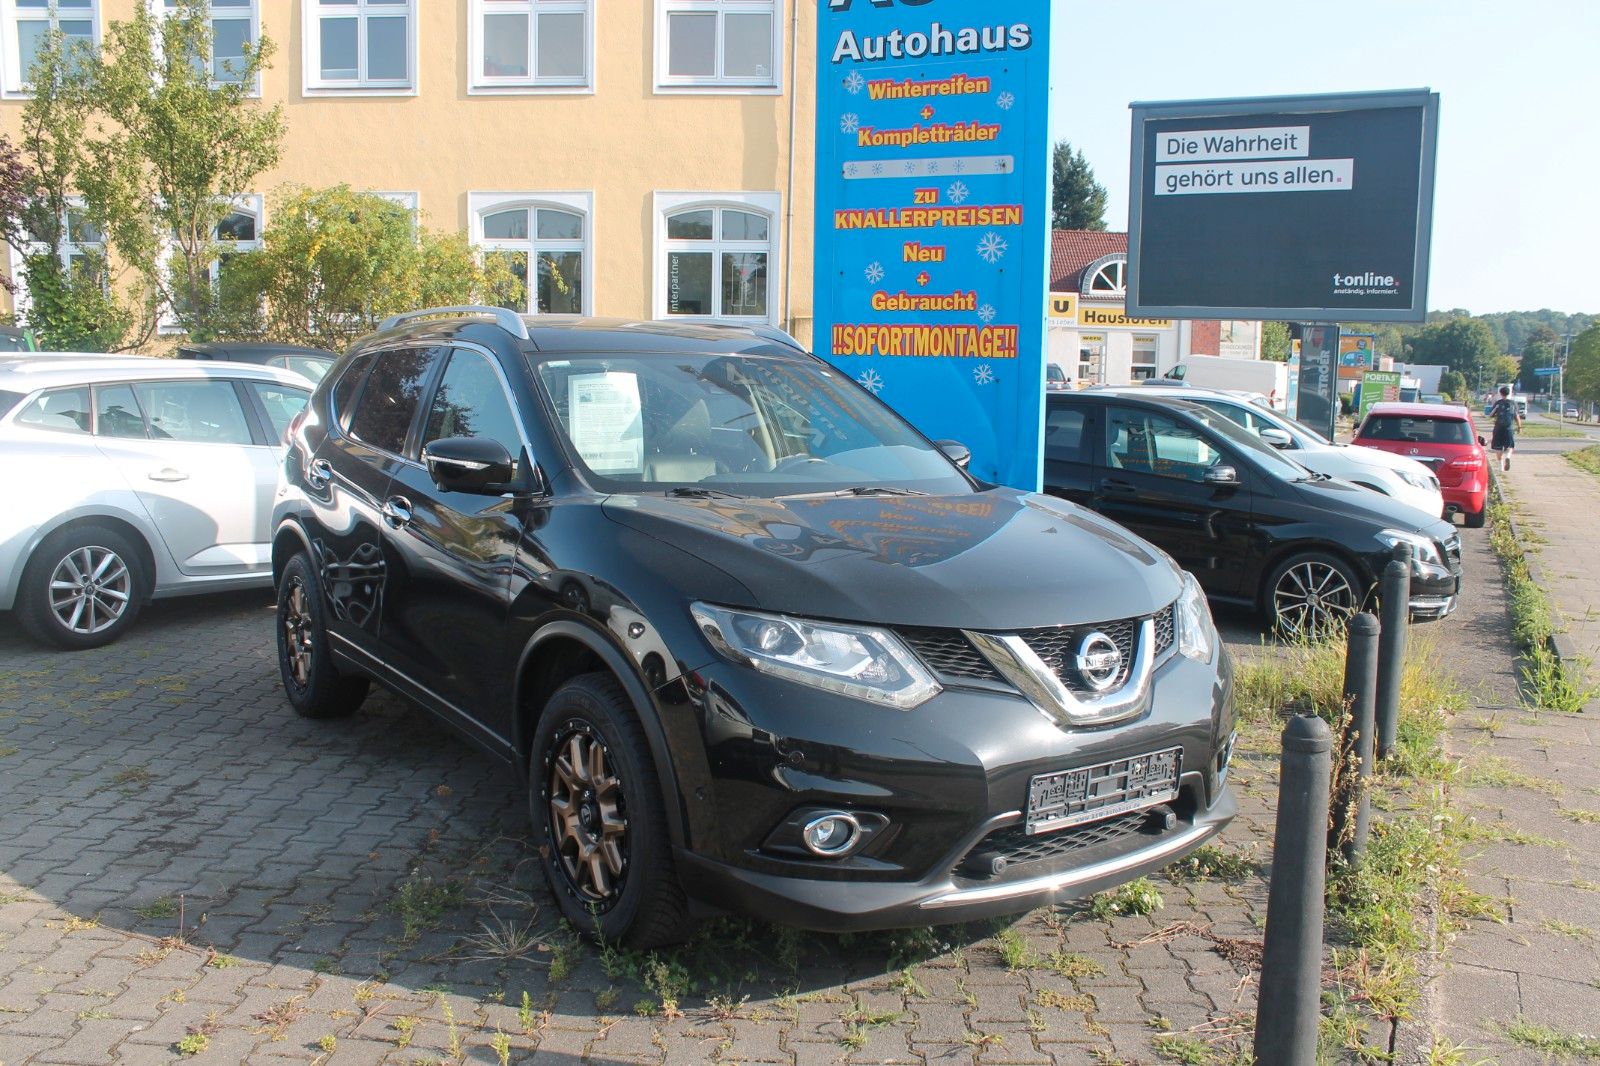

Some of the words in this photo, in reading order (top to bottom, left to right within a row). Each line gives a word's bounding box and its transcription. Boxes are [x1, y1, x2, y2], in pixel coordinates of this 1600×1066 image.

[831, 22, 1032, 63] Autohaus
[867, 74, 990, 101] Winterreifen
[857, 121, 999, 148] Kompletträder
[1167, 138, 1198, 155] Die
[1204, 133, 1298, 154] Wahrheit
[1166, 169, 1233, 193] gehört
[1241, 171, 1278, 186] uns
[1283, 166, 1342, 184] allen.
[913, 188, 938, 204] zu
[834, 206, 1022, 229] KNALLERPREISEN
[902, 242, 945, 262] Neu
[671, 254, 680, 313] interpartner
[870, 291, 977, 311] Gebraucht
[832, 325, 1018, 358] !!SOFORTMONTAGE!!
[1085, 654, 1120, 668] NISSAN
